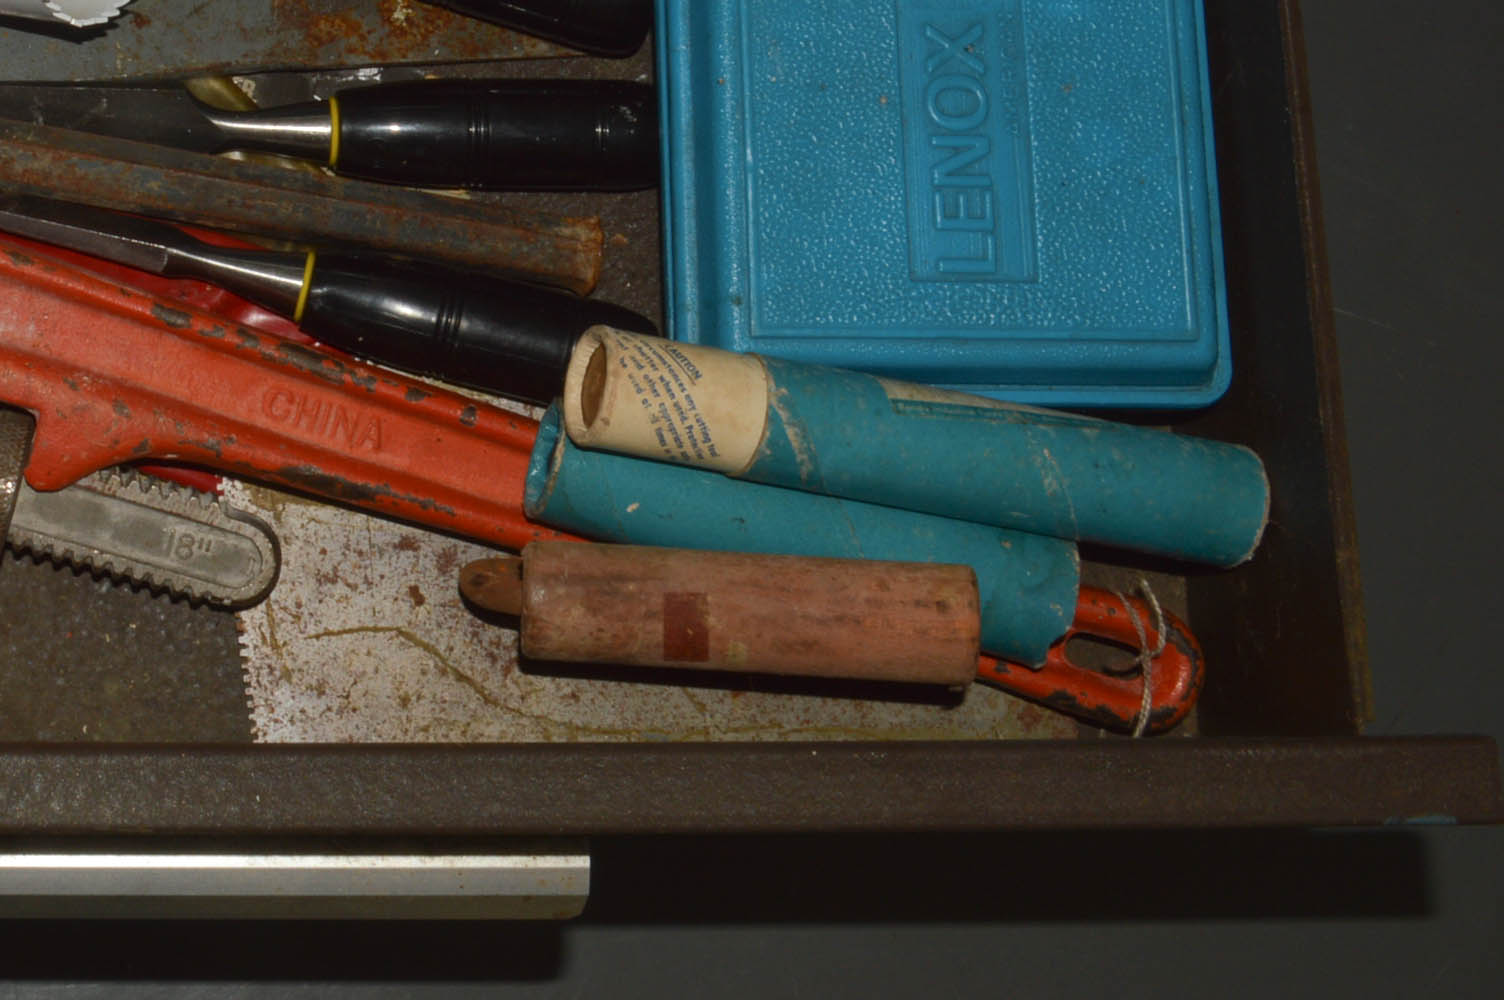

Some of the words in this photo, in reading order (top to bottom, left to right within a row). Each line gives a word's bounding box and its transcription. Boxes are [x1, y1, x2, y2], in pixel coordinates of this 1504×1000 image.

[926, 22, 996, 273] LENOX
[262, 385, 383, 451] CHINA
[165, 527, 213, 561] 18"
